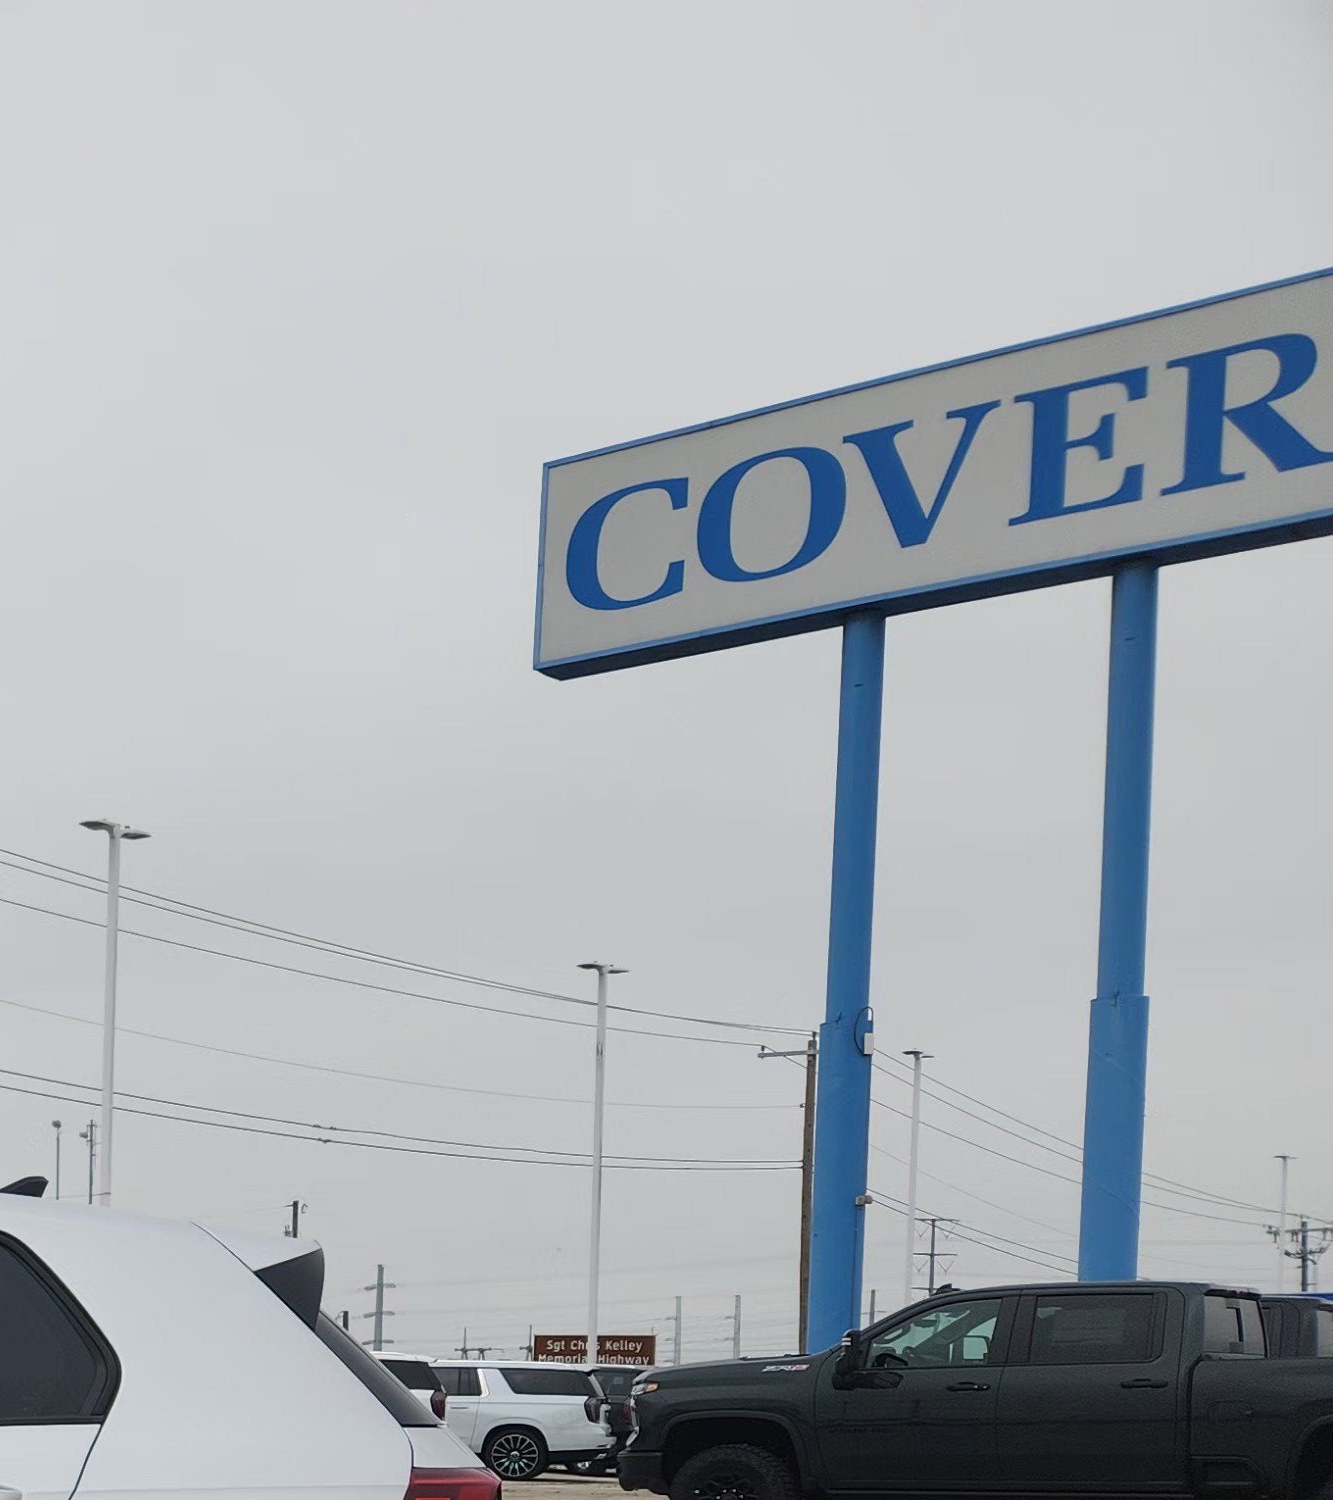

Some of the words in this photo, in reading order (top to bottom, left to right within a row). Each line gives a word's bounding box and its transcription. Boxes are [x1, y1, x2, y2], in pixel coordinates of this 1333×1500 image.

[564, 332, 1333, 612] COVER
[546, 1340, 566, 1353] Sgt
[570, 1339, 601, 1351] Chs
[605, 1339, 643, 1353] Kelley
[538, 1354, 590, 1365] Memoria
[598, 1353, 650, 1366] Highway
